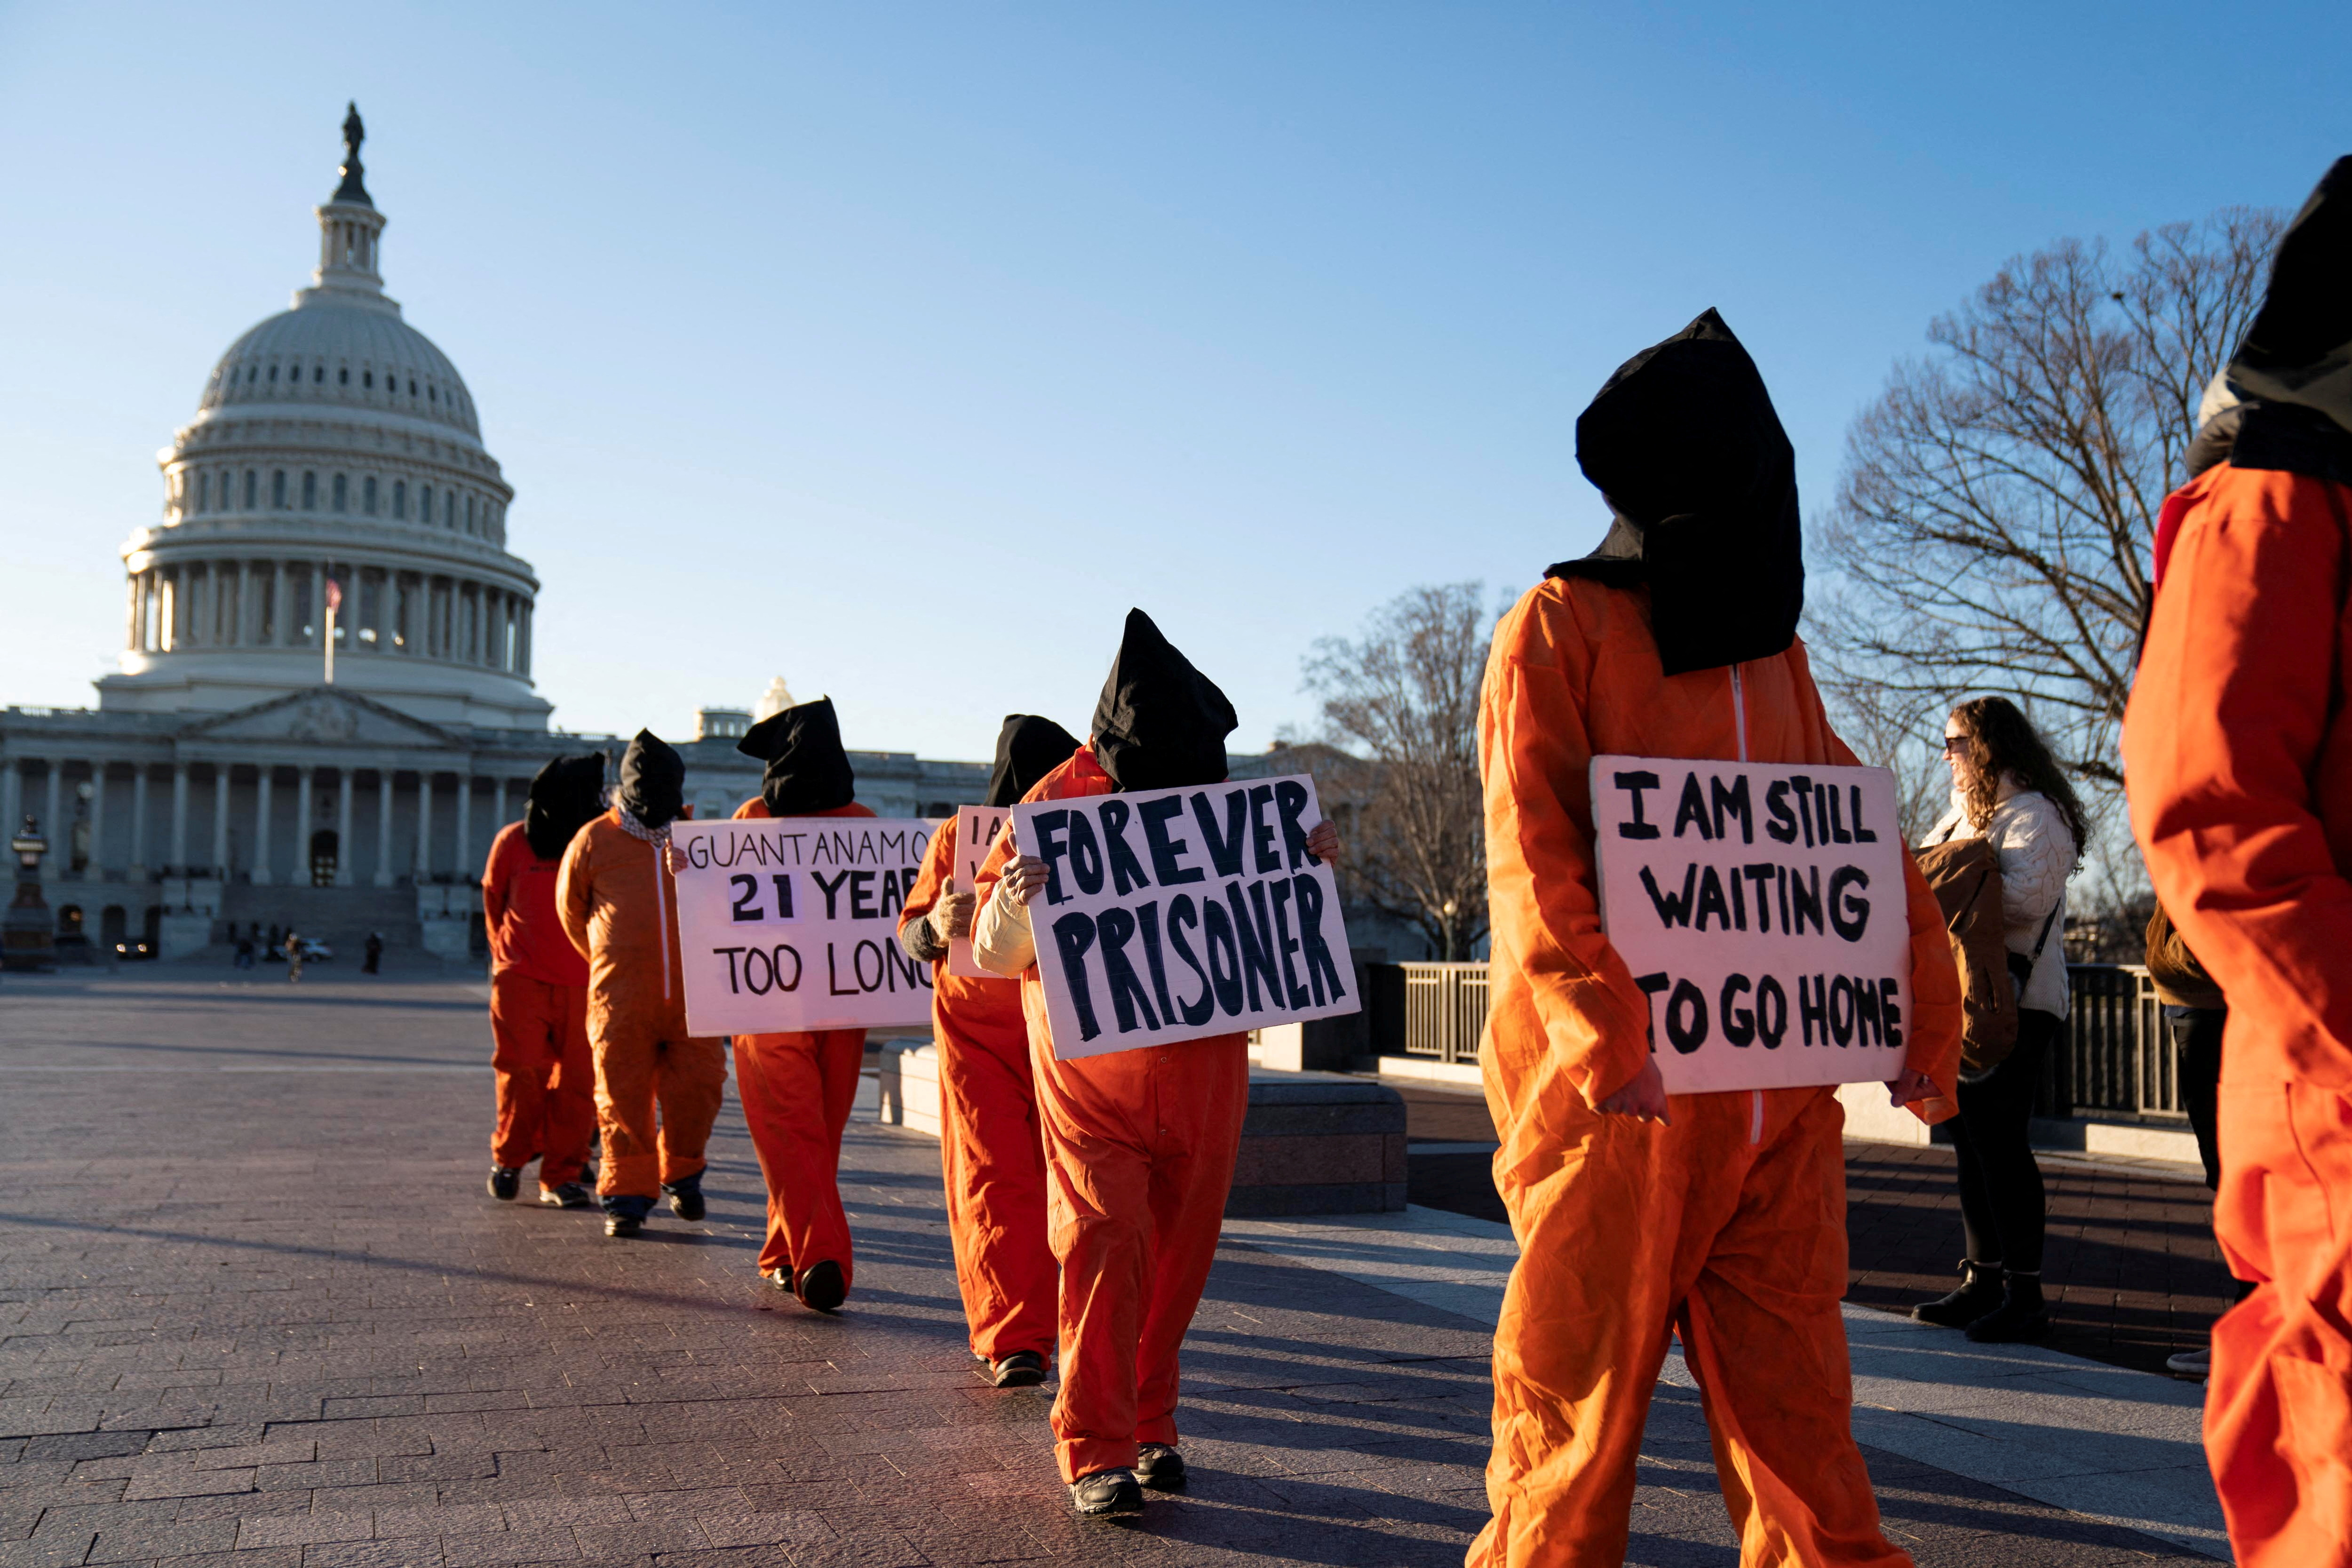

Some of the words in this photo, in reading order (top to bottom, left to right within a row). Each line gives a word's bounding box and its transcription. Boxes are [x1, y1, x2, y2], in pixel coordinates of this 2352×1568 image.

[1032, 780, 1323, 906] FOREVER
[1613, 771, 1661, 840] I
[1673, 772, 1754, 844] AM
[1765, 775, 1877, 848] STILL
[688, 830, 929, 869] GUANTANAMO
[730, 874, 794, 922] 21
[1639, 862, 1870, 942] WAITING
[713, 944, 803, 996] TOO
[1051, 873, 1346, 1043] PRISONER
[1634, 971, 1708, 1055] TO
[1720, 973, 1788, 1050] GO
[1798, 973, 1904, 1049] HOME
